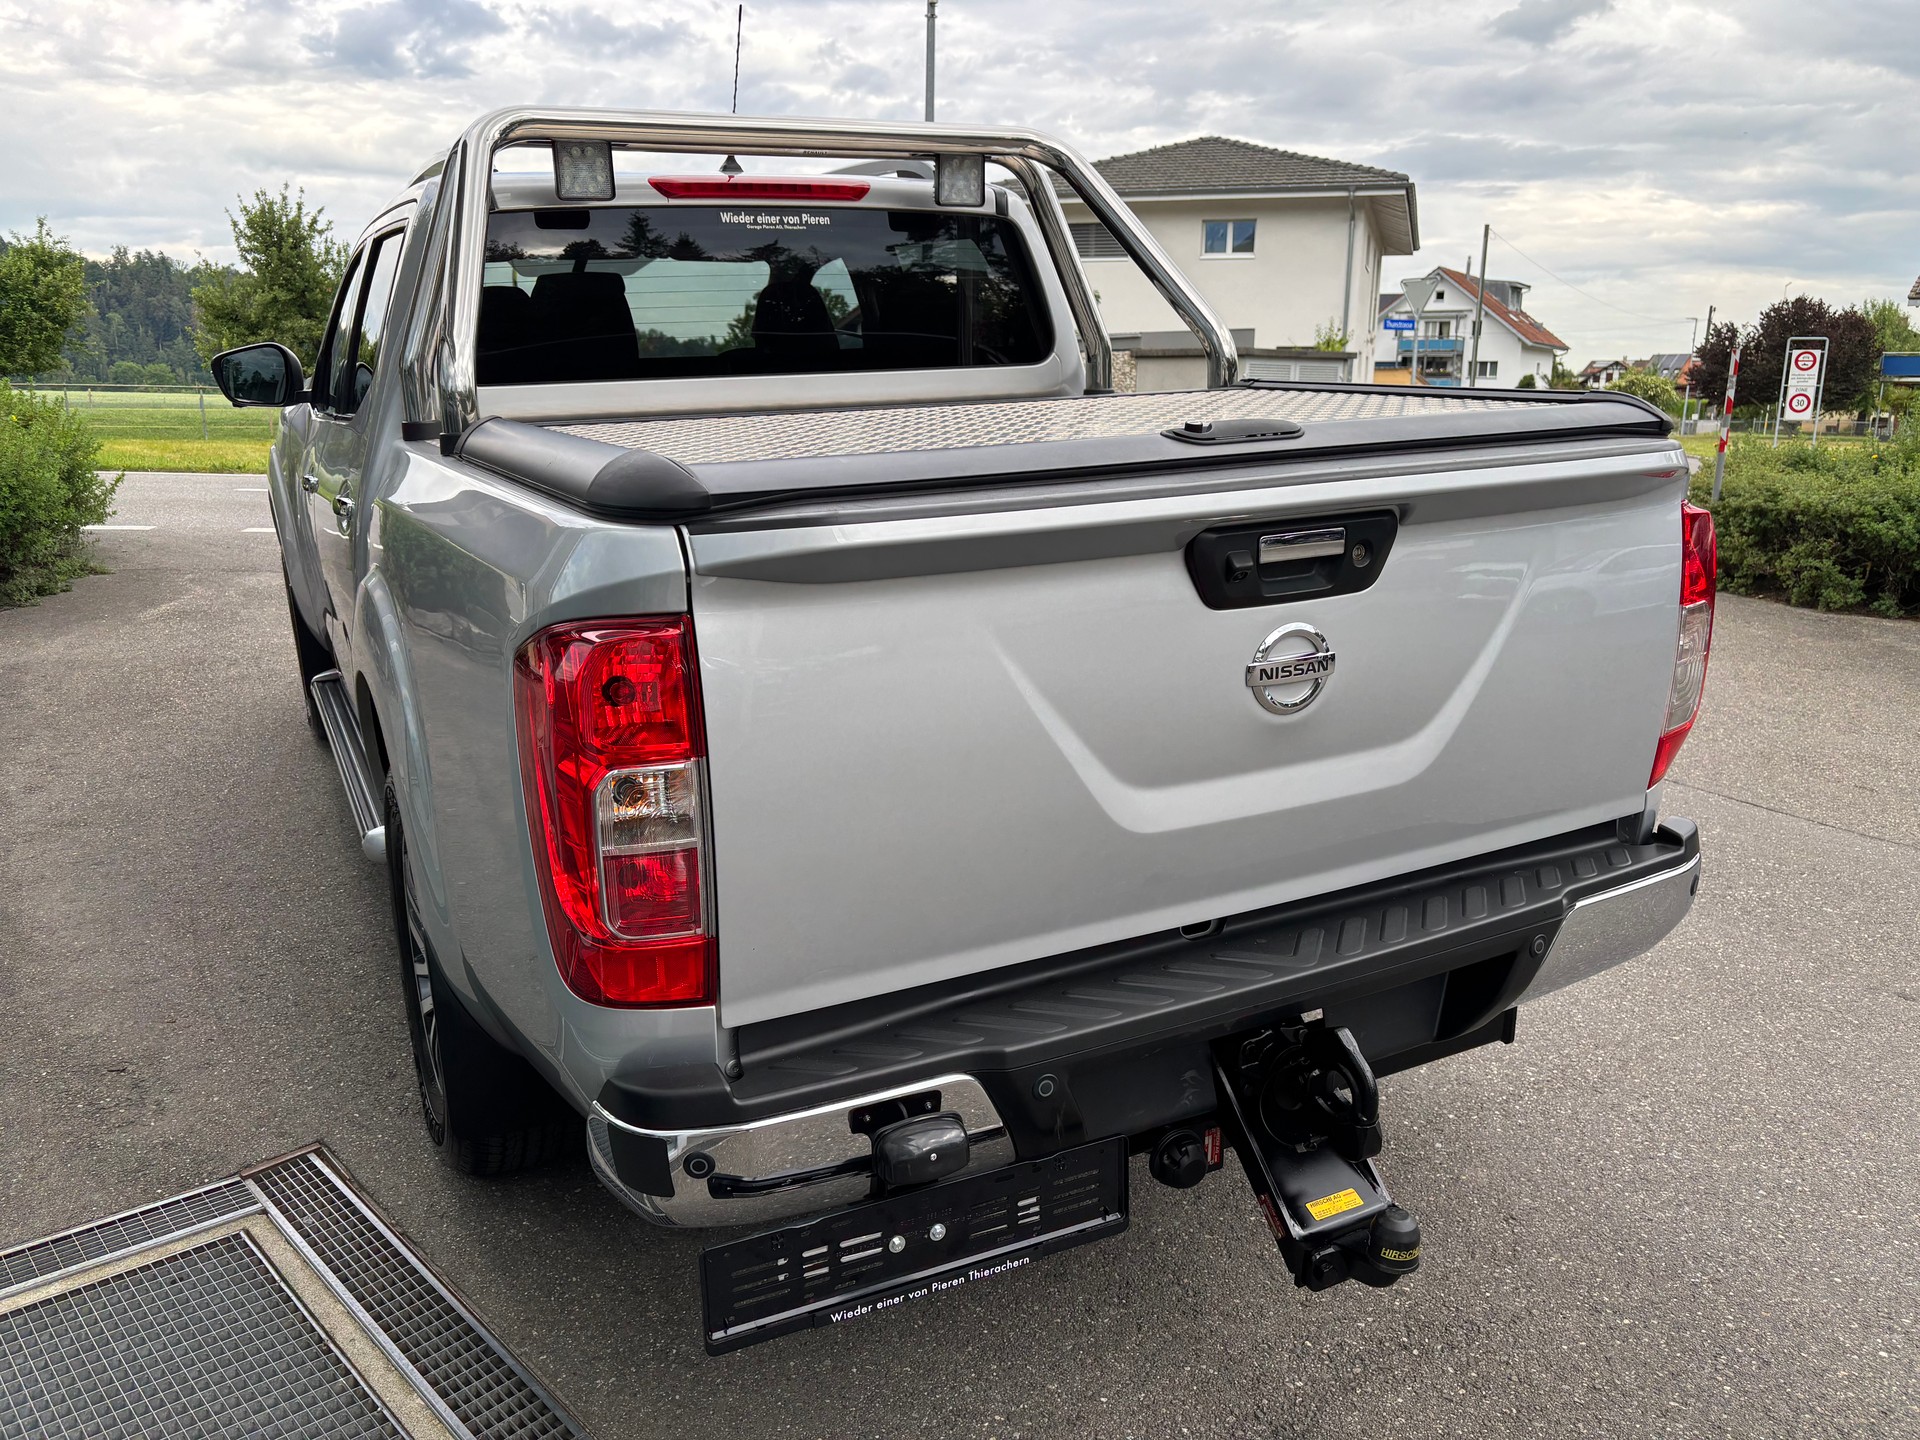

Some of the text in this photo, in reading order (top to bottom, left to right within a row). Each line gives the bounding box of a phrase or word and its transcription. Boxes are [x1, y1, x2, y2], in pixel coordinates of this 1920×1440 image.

[720, 211, 830, 225] Wieder einer von Pieren
[1795, 399, 1805, 407] 30
[1259, 660, 1329, 682] NISSAN
[1310, 1196, 1333, 1209] HIRSCHI
[830, 1256, 1030, 1323] Wieder einer von Pieren Thierachern
